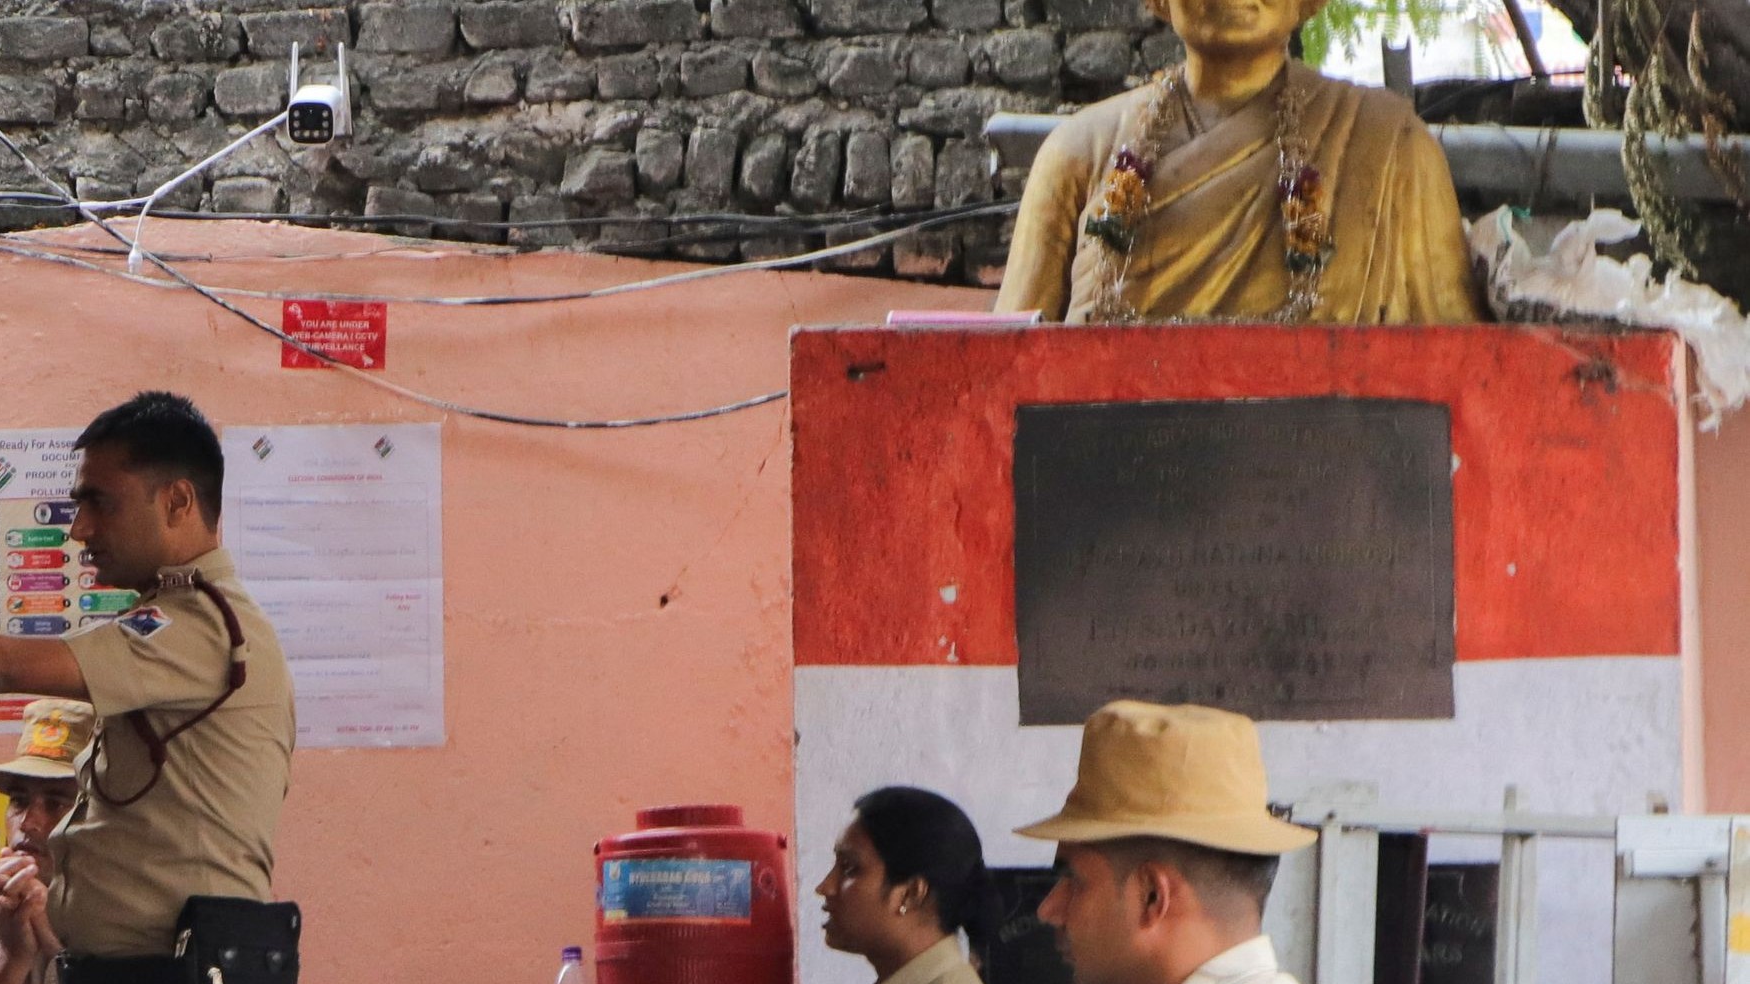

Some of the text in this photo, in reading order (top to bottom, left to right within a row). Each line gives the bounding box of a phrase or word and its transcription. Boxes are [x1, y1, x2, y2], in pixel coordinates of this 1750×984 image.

[300, 320, 369, 329] YOU ARE UNDER
[0, 439, 28, 452] Ready
[31, 439, 46, 449] For
[25, 470, 74, 480] PROOF OF
